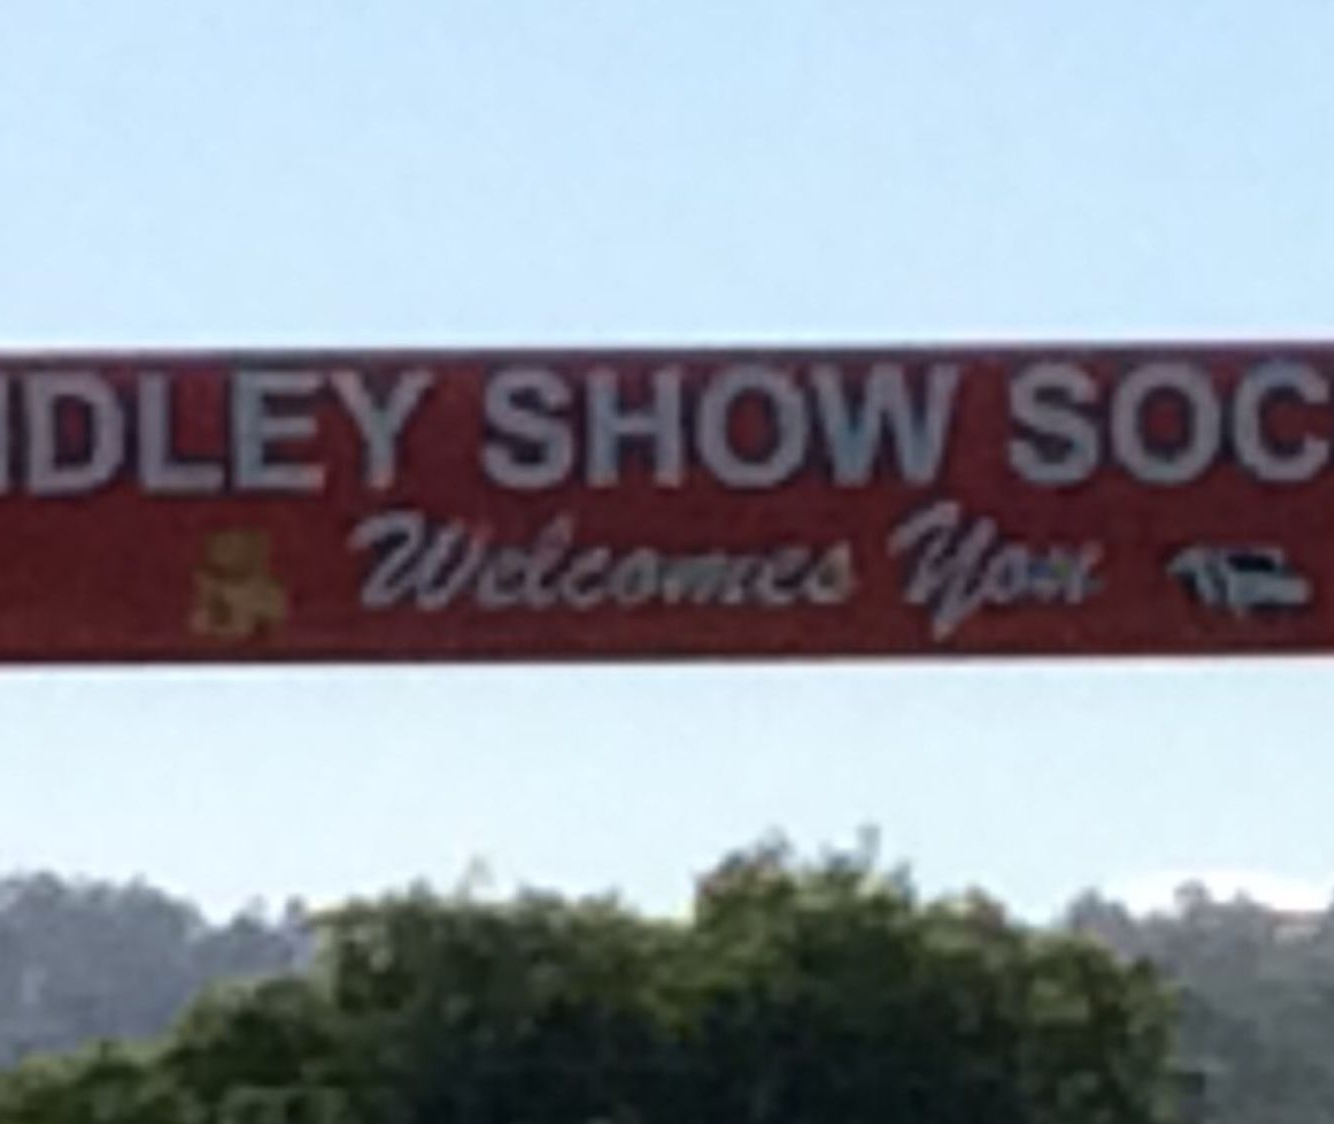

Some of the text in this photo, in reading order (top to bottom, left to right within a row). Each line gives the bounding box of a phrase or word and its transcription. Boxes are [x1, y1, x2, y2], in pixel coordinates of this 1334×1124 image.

[479, 364, 959, 492] SHOW
[347, 500, 1105, 642] Welcomes You
